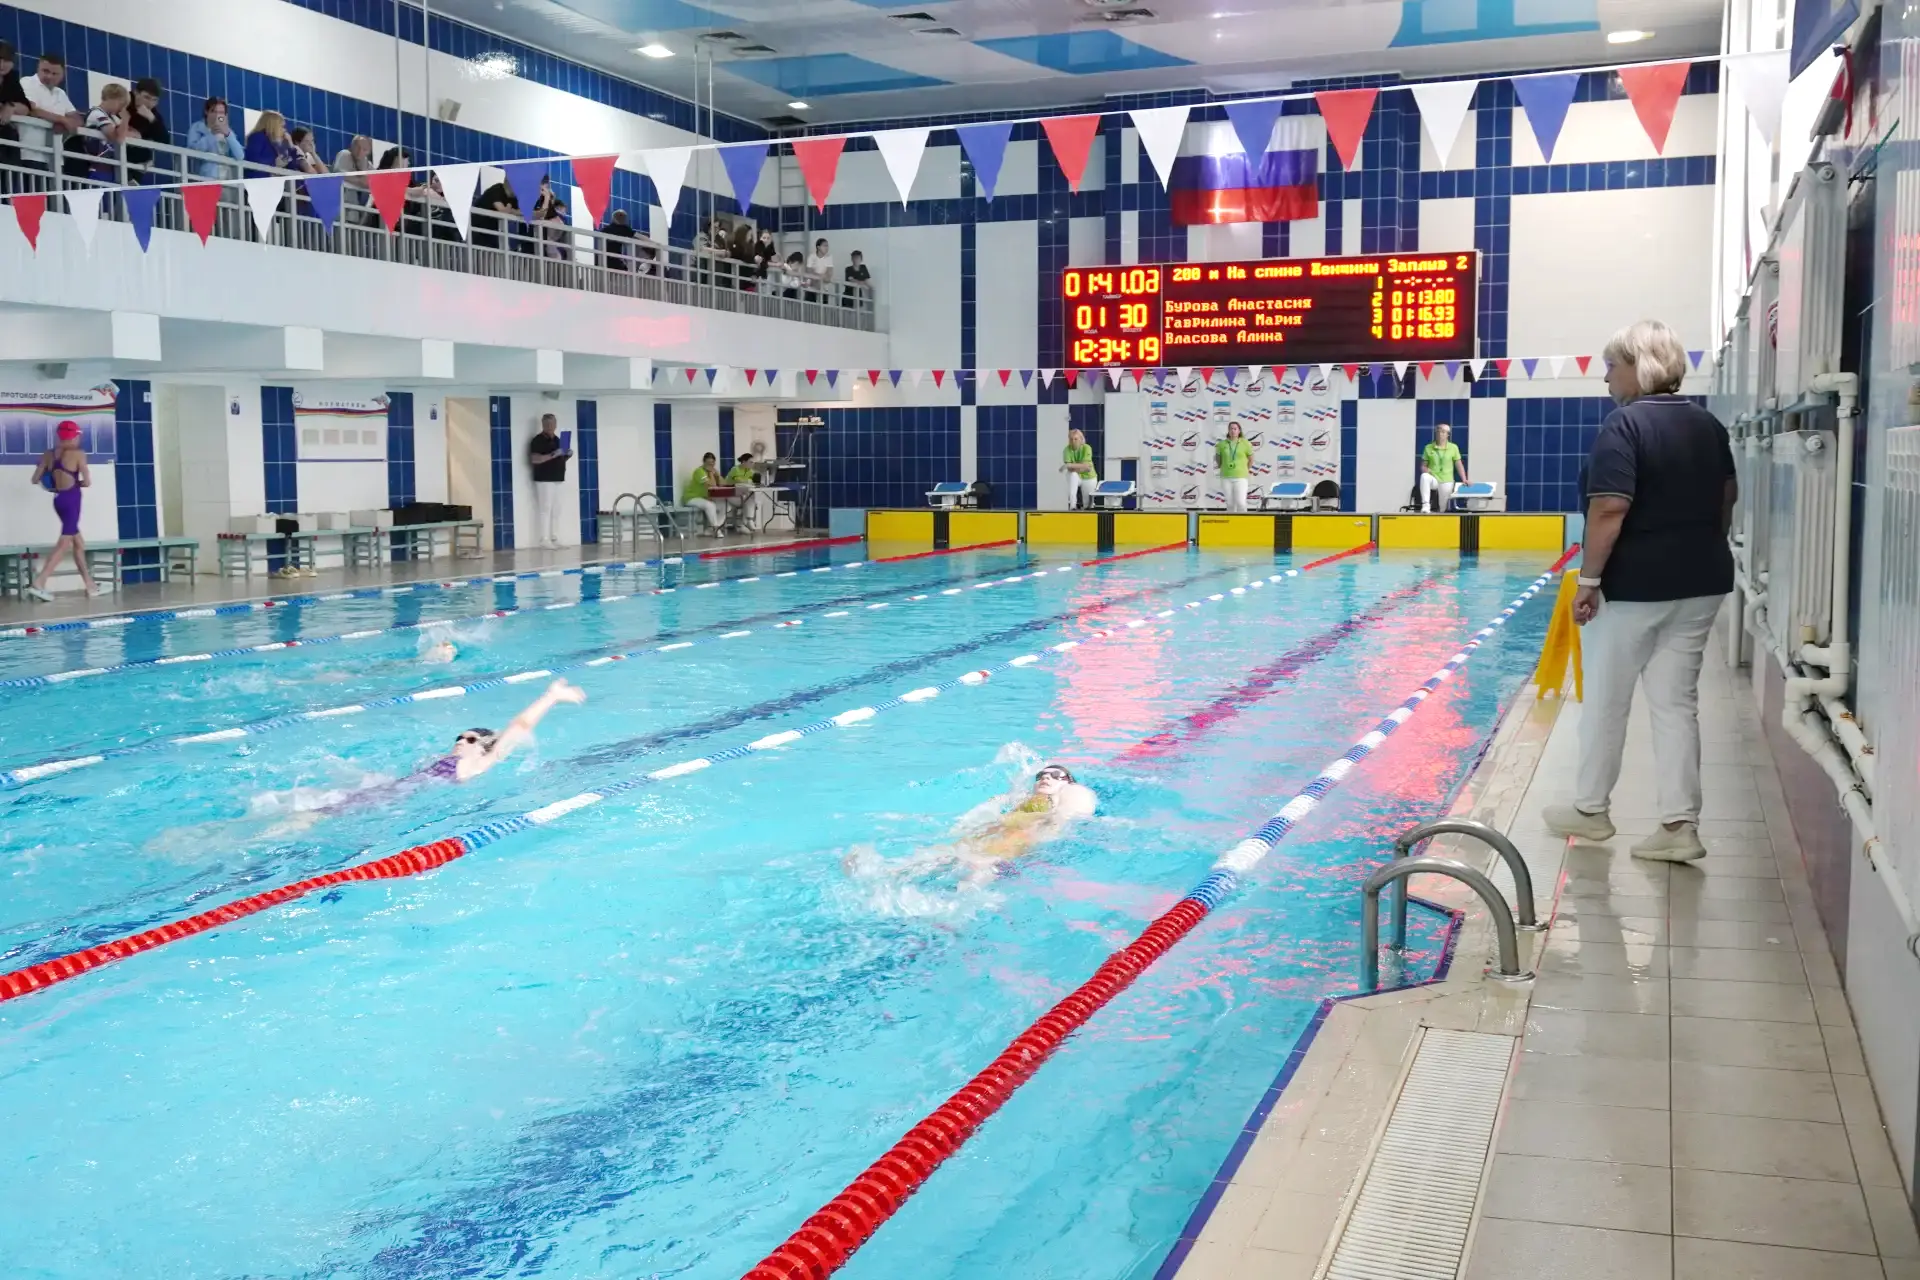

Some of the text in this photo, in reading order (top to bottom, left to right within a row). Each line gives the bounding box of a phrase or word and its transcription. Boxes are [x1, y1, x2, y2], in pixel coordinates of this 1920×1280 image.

[1173, 255, 1468, 281] 200 м На спине Женщины Заплыв 2
[1165, 300, 1219, 313] Бурова
[1228, 298, 1313, 311] Анастасия
[1372, 291, 1383, 307] 2
[1119, 303, 1148, 329] 30
[1165, 316, 1247, 329] Гаврилина
[1255, 313, 1303, 326] Мария
[1373, 308, 1383, 323] 3
[1165, 332, 1228, 345] Власова
[1236, 329, 1284, 343] Алина
[1371, 325, 1383, 339] 4
[0, 391, 37, 400] ПРОТОКОЛ
